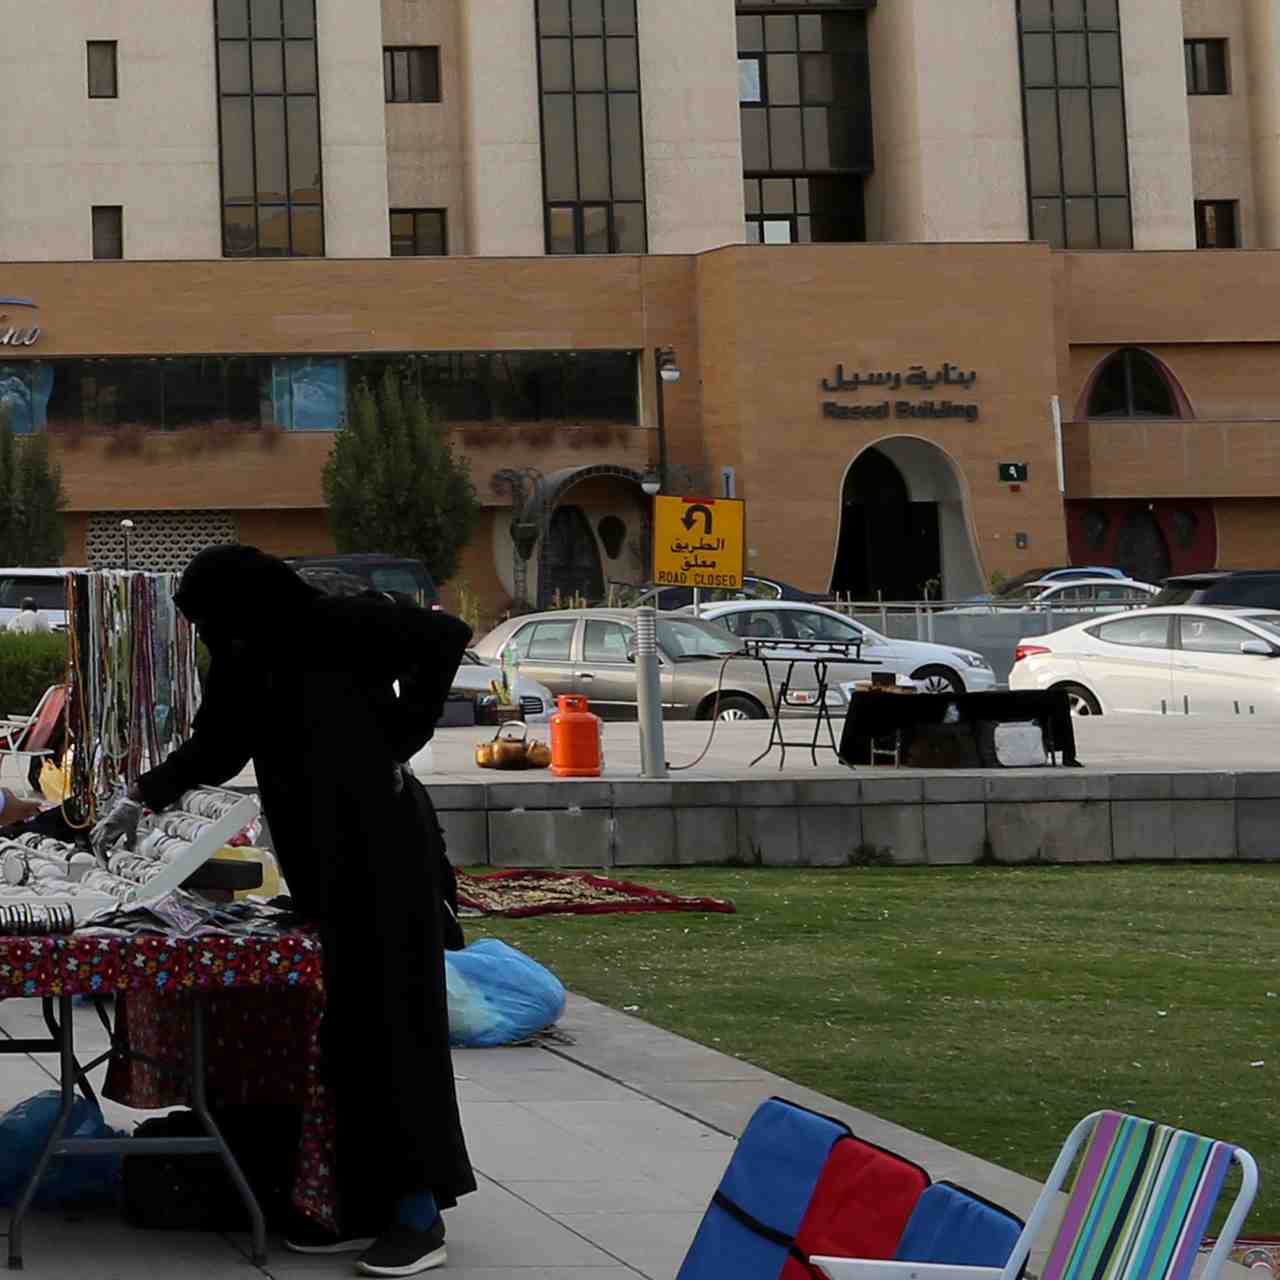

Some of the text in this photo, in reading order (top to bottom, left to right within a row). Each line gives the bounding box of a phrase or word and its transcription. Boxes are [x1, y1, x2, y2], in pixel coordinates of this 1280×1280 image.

[821, 363, 977, 392] بناية رسيل
[894, 401, 978, 423] Building
[671, 537, 726, 553] الطريق
[658, 571, 737, 587] ROAD CLOSED
